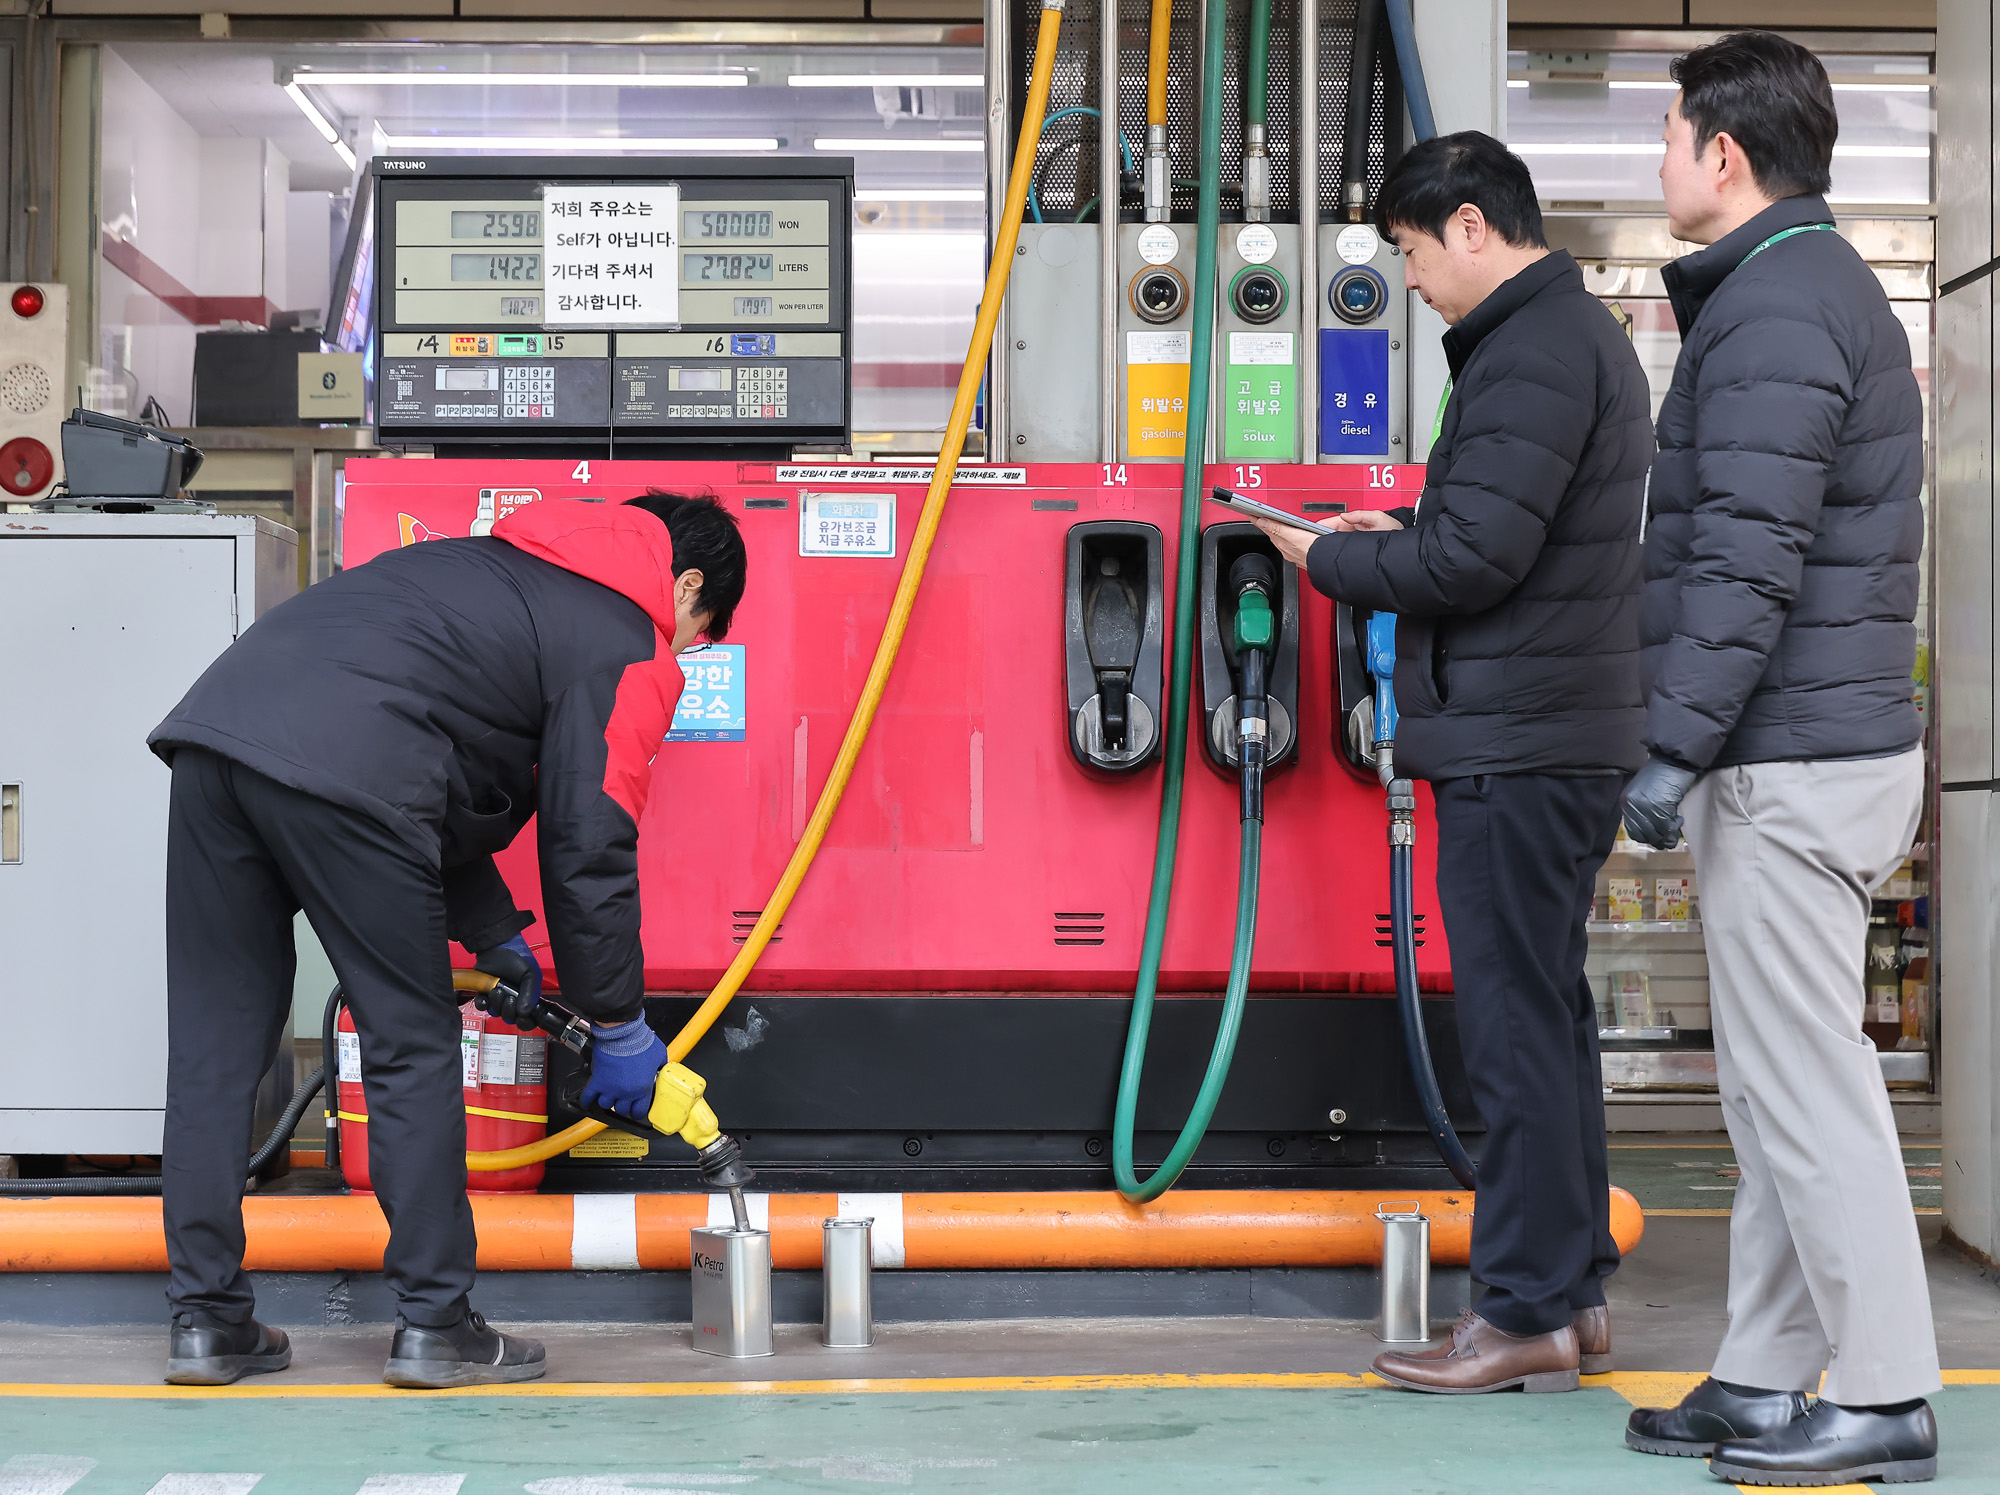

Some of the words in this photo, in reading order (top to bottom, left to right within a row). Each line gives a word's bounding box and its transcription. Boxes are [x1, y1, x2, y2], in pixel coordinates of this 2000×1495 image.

[383, 161, 426, 170] TATSUNO
[551, 201, 582, 217] 저희
[589, 201, 654, 217] 주유소는
[483, 213, 538, 237] 2598
[701, 213, 770, 237] 50000
[778, 220, 799, 229] WON
[557, 232, 601, 248] Self가
[607, 231, 675, 248] 아닙니다.
[490, 256, 538, 280] 1.422
[551, 263, 599, 279] 기다려
[606, 263, 654, 279] 주셔서
[778, 263, 809, 272] LITERS
[557, 294, 642, 310] 감사합니다.
[416, 335, 440, 354] 14
[548, 336, 565, 350] 15
[706, 337, 724, 353] 16
[507, 369, 513, 378] 7
[520, 369, 526, 378] 8
[532, 369, 539, 378] 9
[740, 369, 747, 378] 7
[753, 369, 759, 378] 8
[766, 369, 772, 378] 9
[507, 382, 513, 390] 4
[520, 382, 526, 390] 5
[532, 382, 539, 390] 6
[740, 382, 747, 390] 4
[753, 382, 759, 390] 5
[766, 382, 772, 390] 6
[507, 394, 512, 403] 1
[520, 394, 526, 403] 2
[532, 394, 539, 403] 3
[741, 395, 745, 403] 1
[753, 395, 759, 403] 2
[766, 395, 772, 403] 3
[1141, 397, 1185, 413] 휘발유
[436, 407, 446, 415] P1
[449, 407, 459, 415] P2
[461, 407, 472, 415] P3
[474, 407, 485, 415] P4
[487, 407, 498, 415] P5
[531, 407, 539, 416] C
[545, 407, 551, 416] L
[669, 407, 679, 416] P1
[707, 407, 718, 416] P4
[765, 407, 772, 416] C
[778, 407, 784, 416] L
[1236, 399, 1282, 415] 휘발유
[1141, 428, 1185, 441] gasoline
[1243, 430, 1276, 442] solux
[1340, 424, 1371, 435] diesel
[571, 460, 592, 484] 4
[779, 470, 798, 478] 차량
[799, 470, 828, 478] 진입시
[829, 470, 848, 478] 다른
[850, 470, 887, 478] 생각말고
[1001, 471, 1021, 480] 제발
[1102, 464, 1128, 486] 14
[1235, 465, 1262, 488] 15
[1368, 465, 1396, 488] 16
[832, 504, 864, 516] 화물차
[819, 521, 877, 534] 유가보조금
[819, 534, 840, 546] 지급
[843, 534, 876, 547] 주유소
[681, 664, 733, 691] 강한
[675, 694, 731, 719] 유소
[694, 1252, 704, 1268] K
[704, 1256, 724, 1272] Petro
